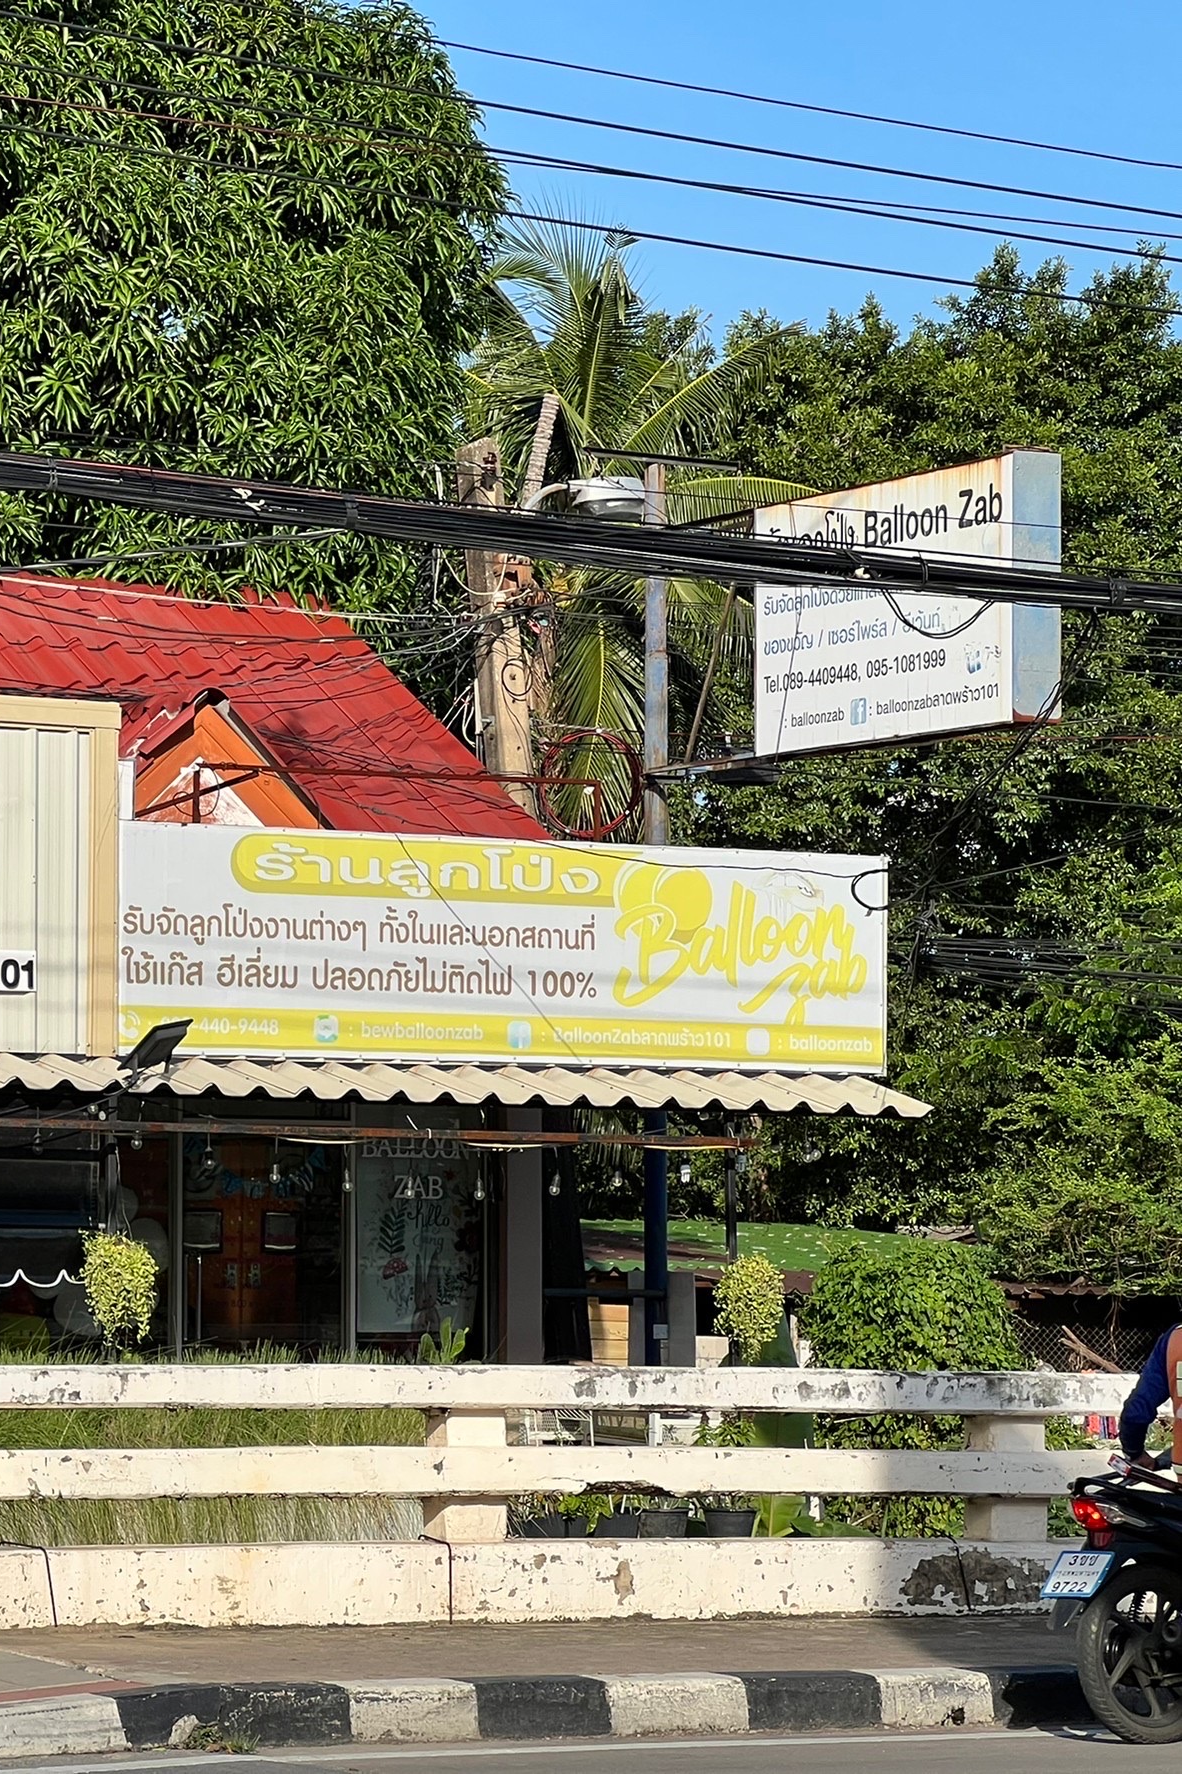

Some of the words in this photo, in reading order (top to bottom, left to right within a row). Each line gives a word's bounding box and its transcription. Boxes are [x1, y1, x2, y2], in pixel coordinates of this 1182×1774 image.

[865, 504, 947, 548] Balloon
[959, 484, 1002, 528] Zab
[764, 632, 814, 656] ของขวัญ
[866, 648, 947, 679] 095-1081999
[791, 707, 845, 728] balloonzab
[254, 842, 601, 898] ร้านลูกโป่ง
[122, 903, 367, 951] รับจัดลูกโป่งงานต่างๆ
[379, 906, 596, 950] ทั้งในและนอกสถานที่
[613, 881, 855, 1007] Balloon
[121, 947, 204, 986] ใช้แก๊ส
[217, 947, 298, 989] ฮีเลี่ยม
[312, 956, 512, 996] ปลอดภัยไม่ติดไฟ
[527, 970, 597, 1000] 100%
[361, 1024, 484, 1042] bewballoonzab
[789, 1036, 873, 1053] balloonzab
[393, 1175, 444, 1200] ZAB
[1051, 1581, 1088, 1593] 9722
